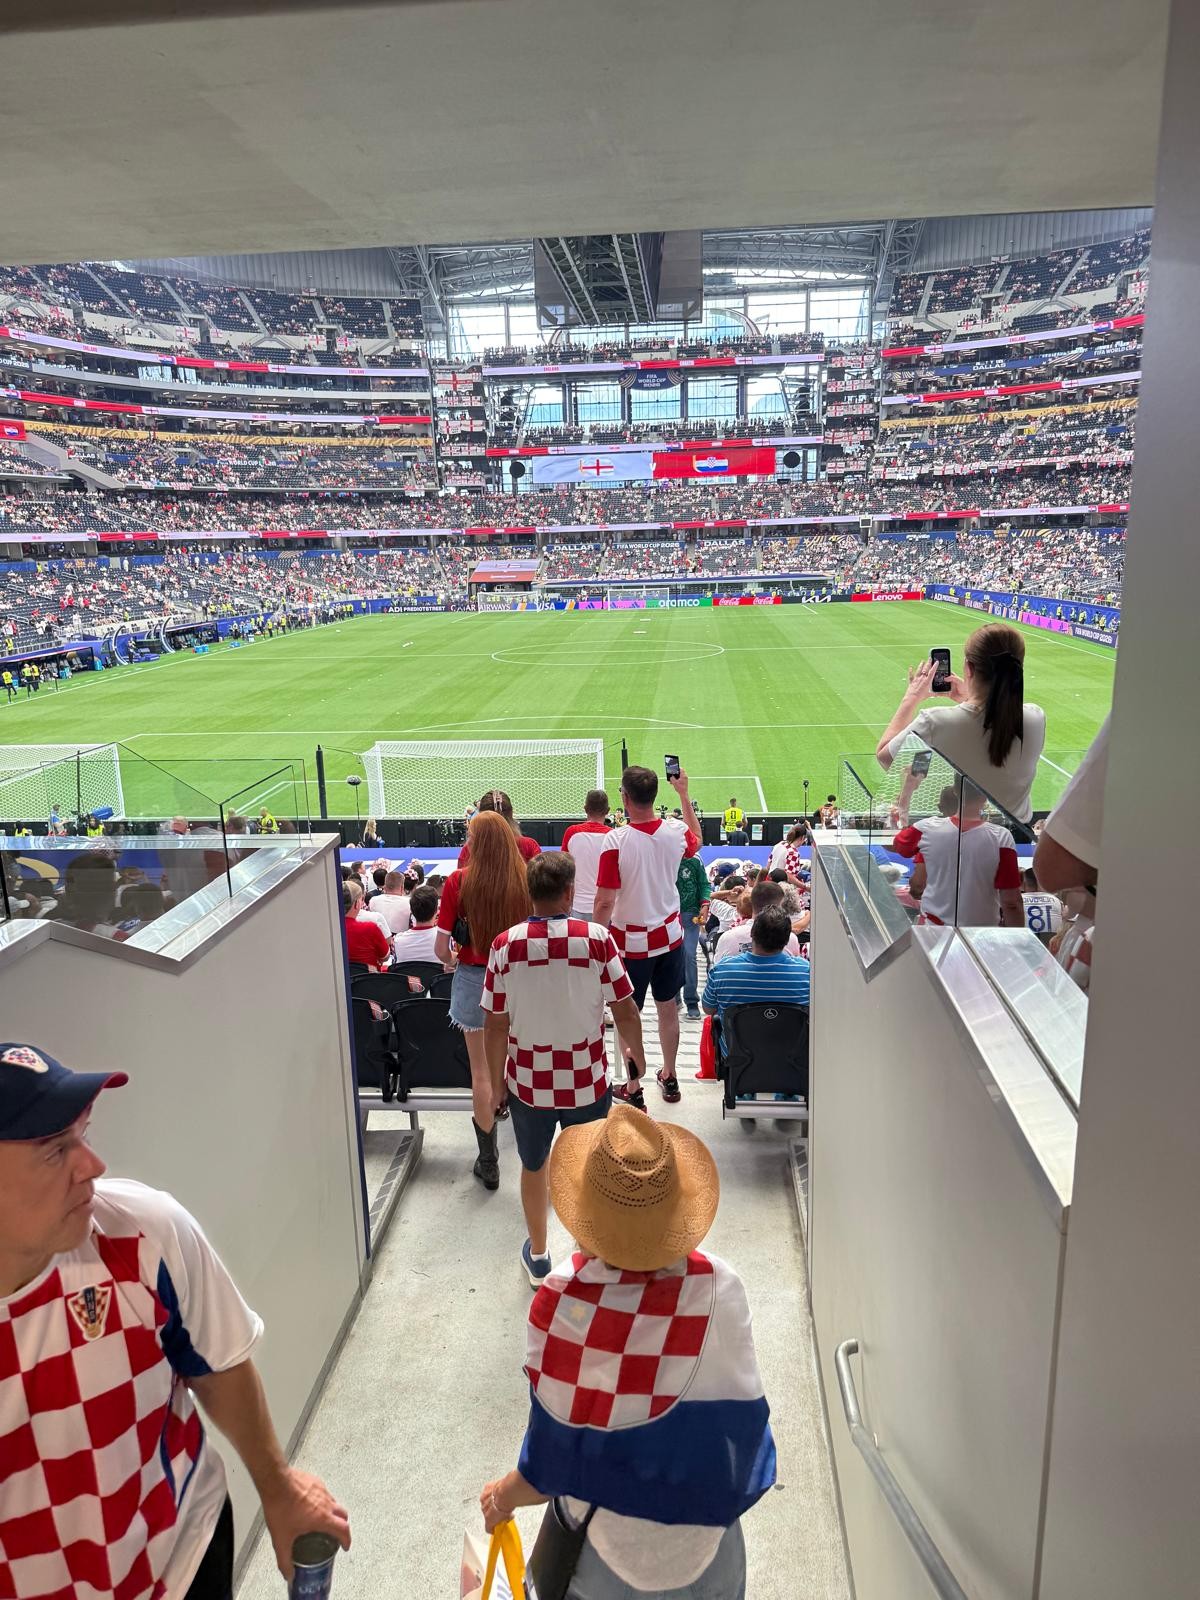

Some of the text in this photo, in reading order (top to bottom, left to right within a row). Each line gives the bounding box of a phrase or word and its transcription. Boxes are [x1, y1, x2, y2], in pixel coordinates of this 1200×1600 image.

[972, 363, 1006, 371] DALLAS
[872, 593, 904, 601] Lenovo
[479, 603, 511, 611] AIRWAYS
[658, 598, 700, 608] aramco
